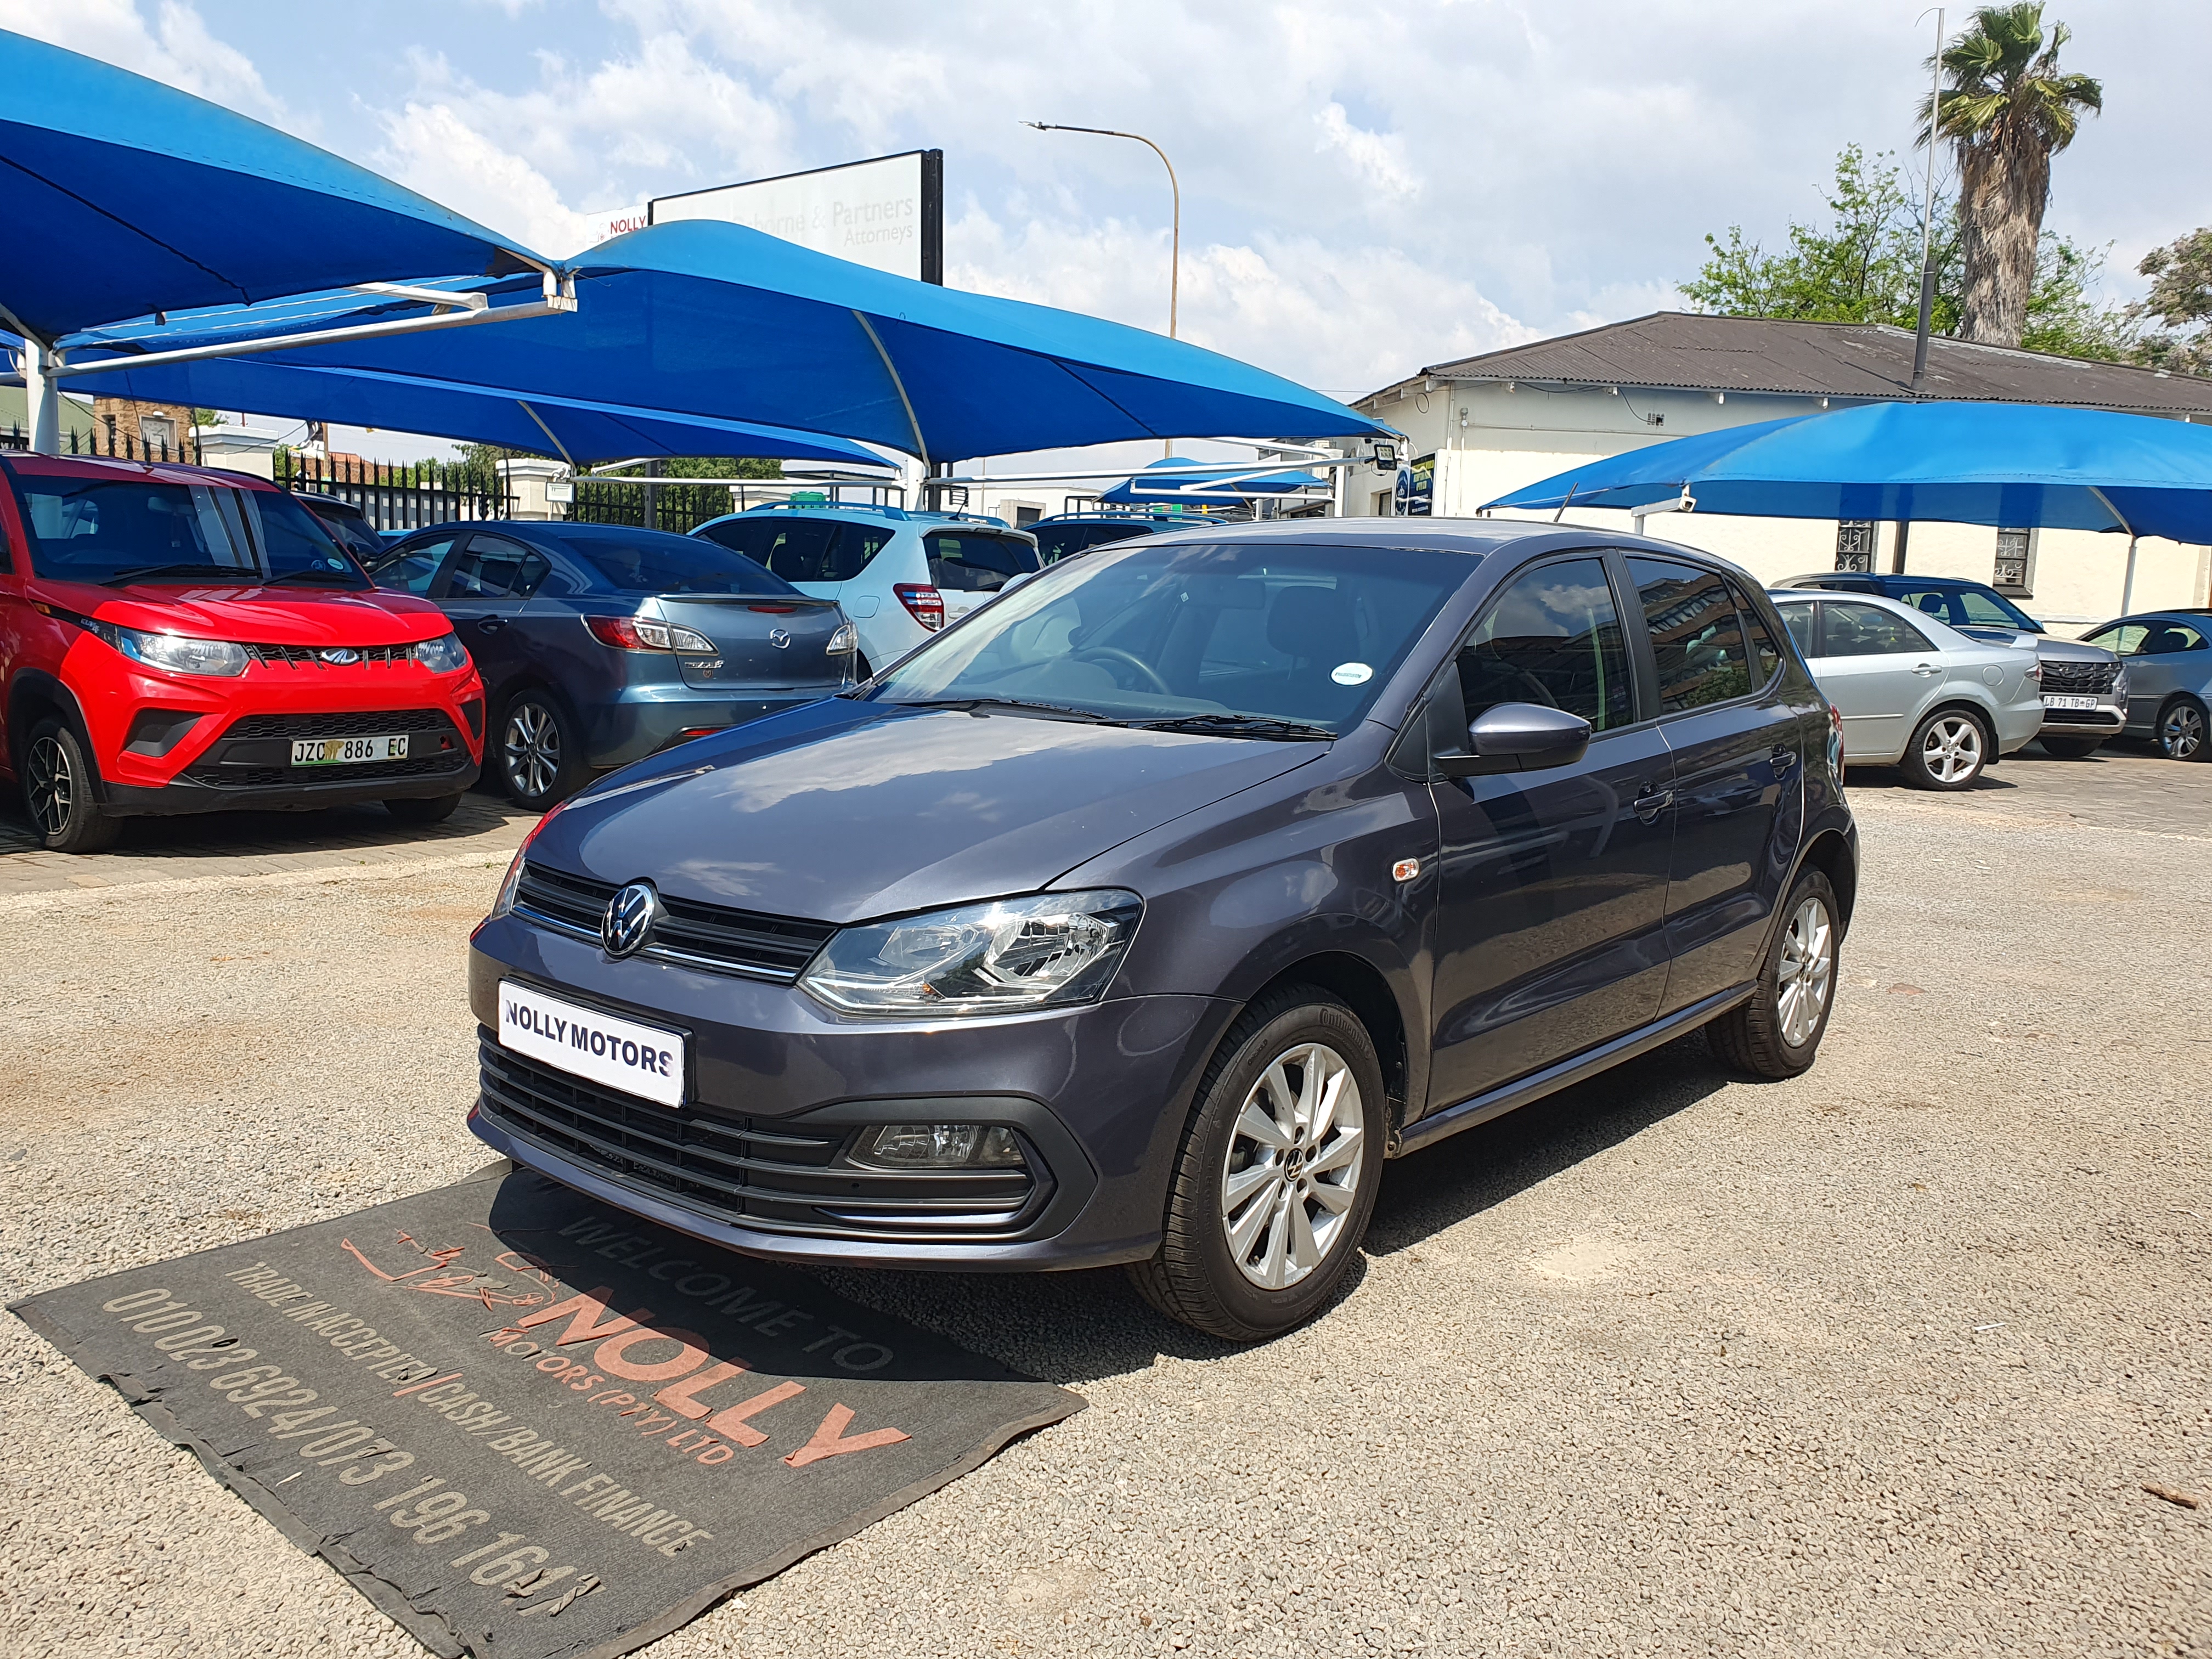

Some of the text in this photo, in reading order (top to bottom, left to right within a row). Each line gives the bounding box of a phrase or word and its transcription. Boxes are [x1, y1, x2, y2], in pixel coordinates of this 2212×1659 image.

[610, 216, 646, 235] NOLLY
[732, 212, 806, 234] borne
[833, 198, 913, 227] Partners
[844, 224, 913, 246] Attorneys
[2045, 697, 2095, 708] LB 71 TB GP
[345, 739, 374, 759] 886
[387, 737, 406, 757] EC
[505, 1000, 674, 1078] NOLLY MOTORS
[558, 1216, 895, 1371] WELCOME TO
[224, 1261, 314, 1307] TRADE
[281, 1300, 338, 1322] IN
[559, 1472, 714, 1558] FINANCE
[481, 1326, 735, 1465] MOTORS (PTY) LTD
[518, 1285, 912, 1467] NOLLY
[102, 1288, 204, 1333] 010
[209, 1364, 415, 1486] 6924/073
[372, 1474, 492, 1544] 196
